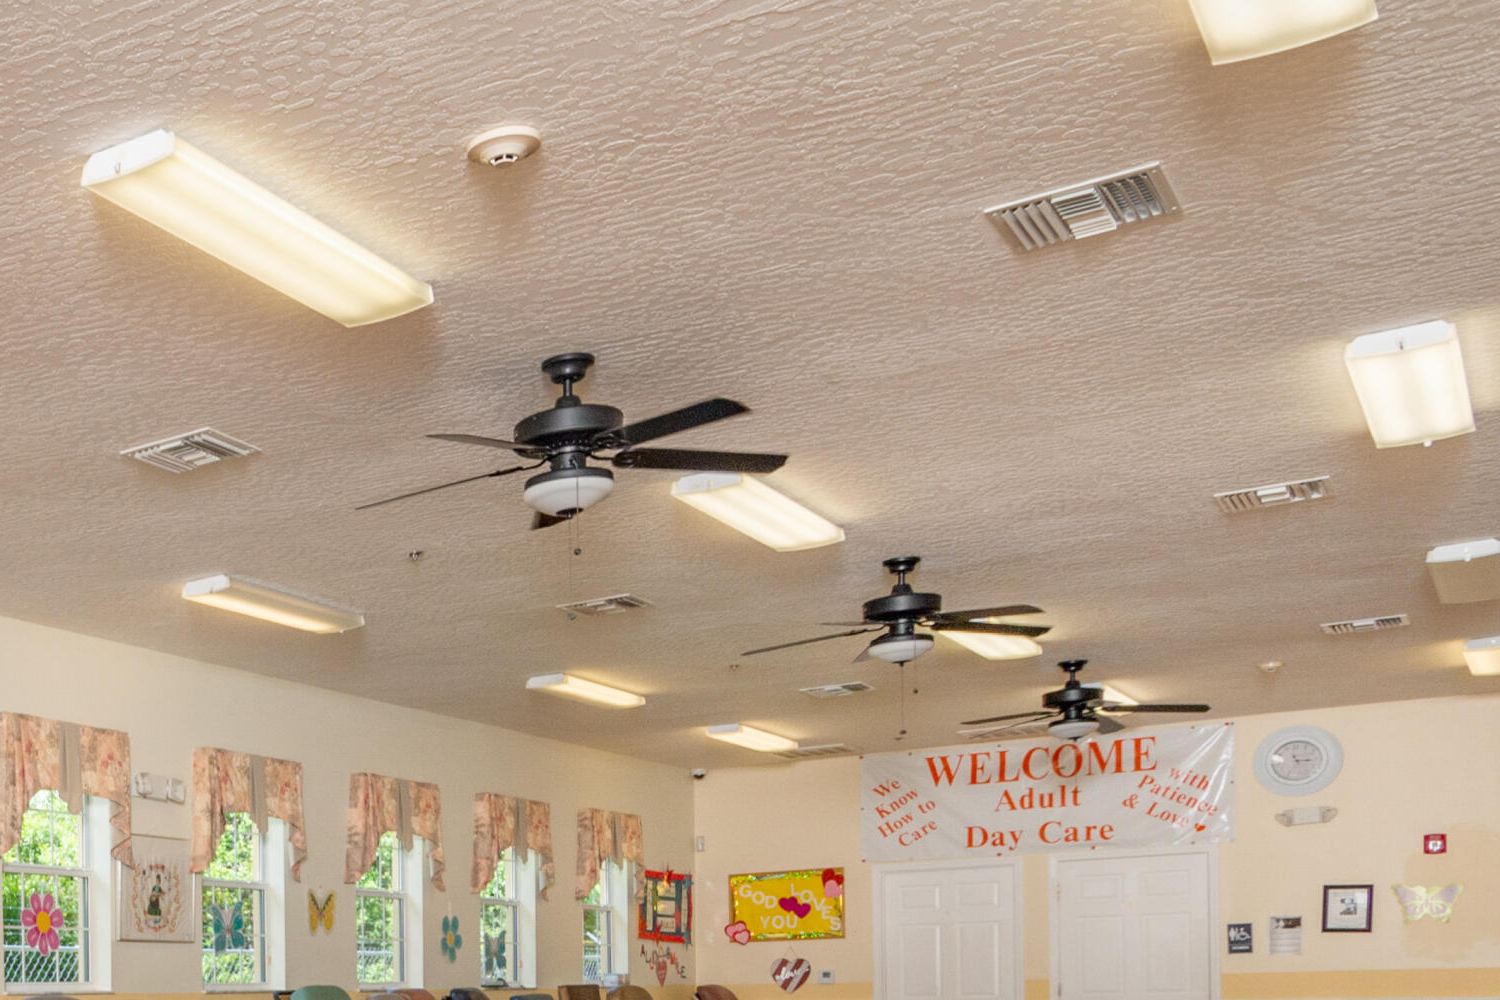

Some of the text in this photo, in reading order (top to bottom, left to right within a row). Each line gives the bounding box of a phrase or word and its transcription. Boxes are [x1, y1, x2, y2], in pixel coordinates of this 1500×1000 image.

[925, 736, 1158, 787] WELCOME
[872, 779, 901, 797] We
[1168, 767, 1210, 792] with
[875, 788, 919, 819] Know
[994, 784, 1083, 812] Adult
[1121, 793, 1190, 827] & Love
[1137, 774, 1219, 817] Patience
[877, 800, 936, 838] How to
[898, 820, 938, 847] Care
[965, 820, 1116, 851] Day Care
[739, 883, 842, 931] GOD LOVES
[760, 914, 798, 929] YOU
